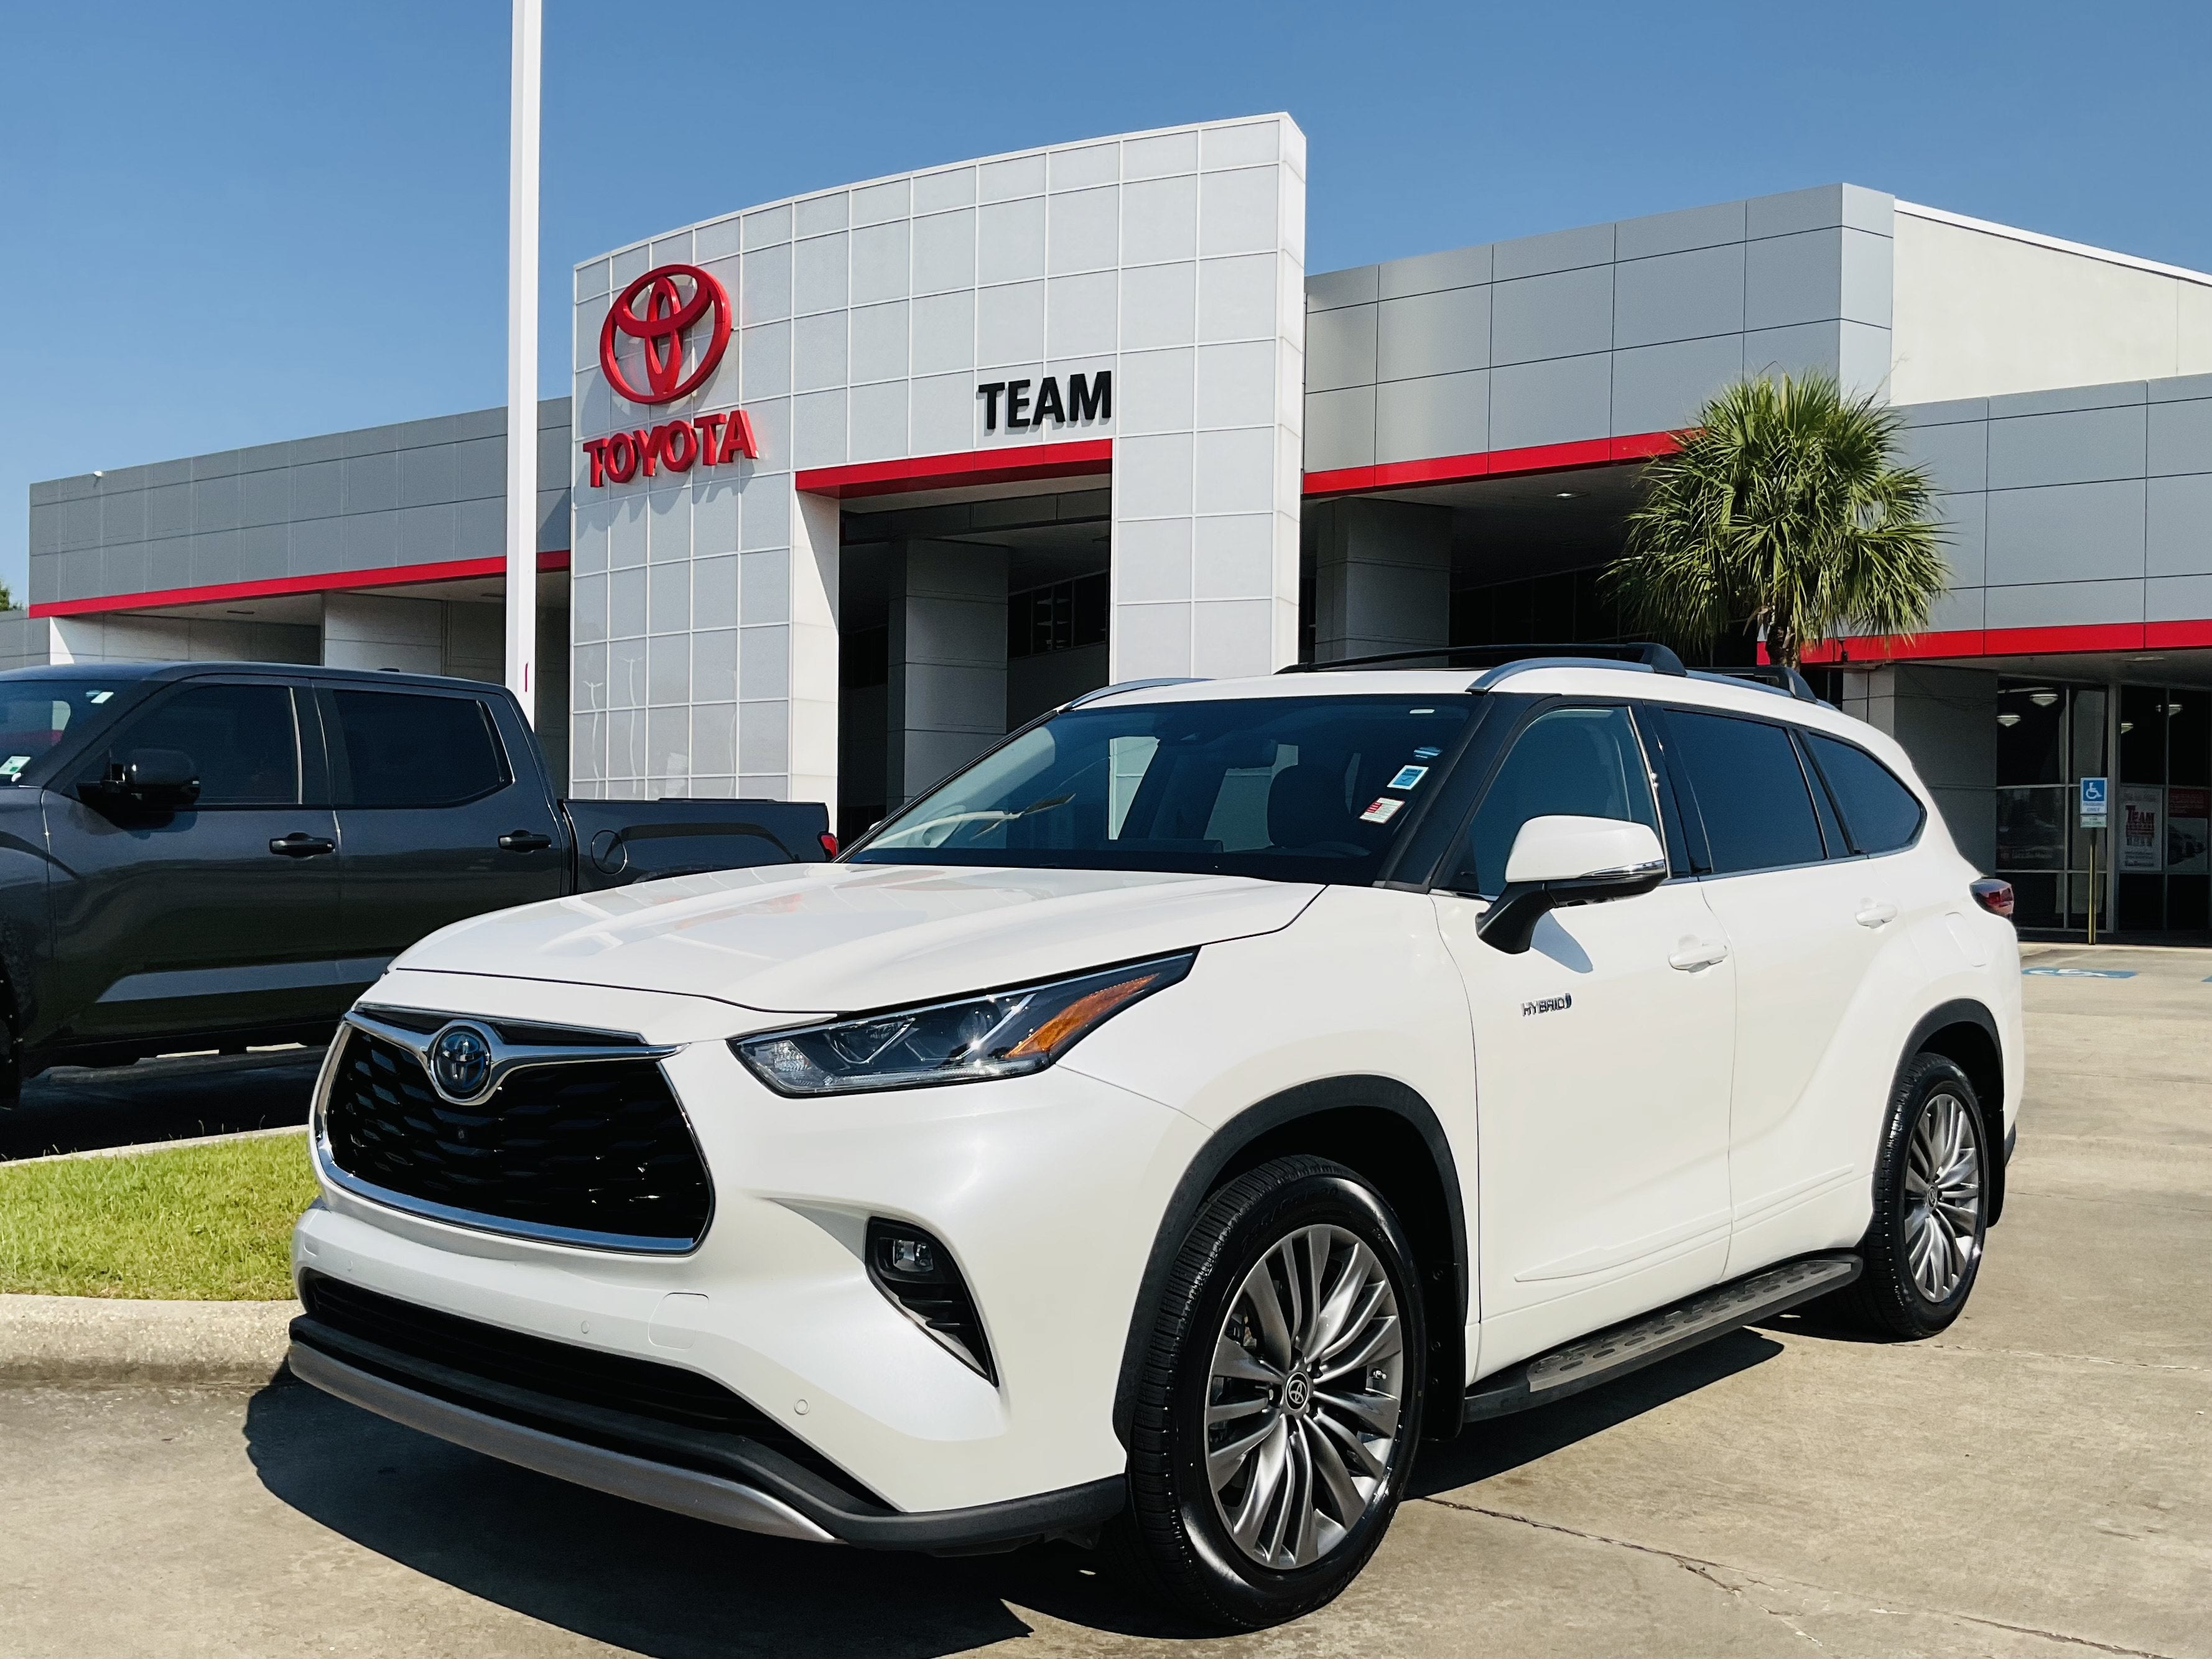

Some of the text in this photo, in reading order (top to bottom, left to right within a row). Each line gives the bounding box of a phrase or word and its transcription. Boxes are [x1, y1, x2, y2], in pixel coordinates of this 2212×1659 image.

[978, 371, 1112, 429] TEAM
[583, 410, 759, 487] TOYOTA
[1520, 997, 1565, 1016] HYBRID
